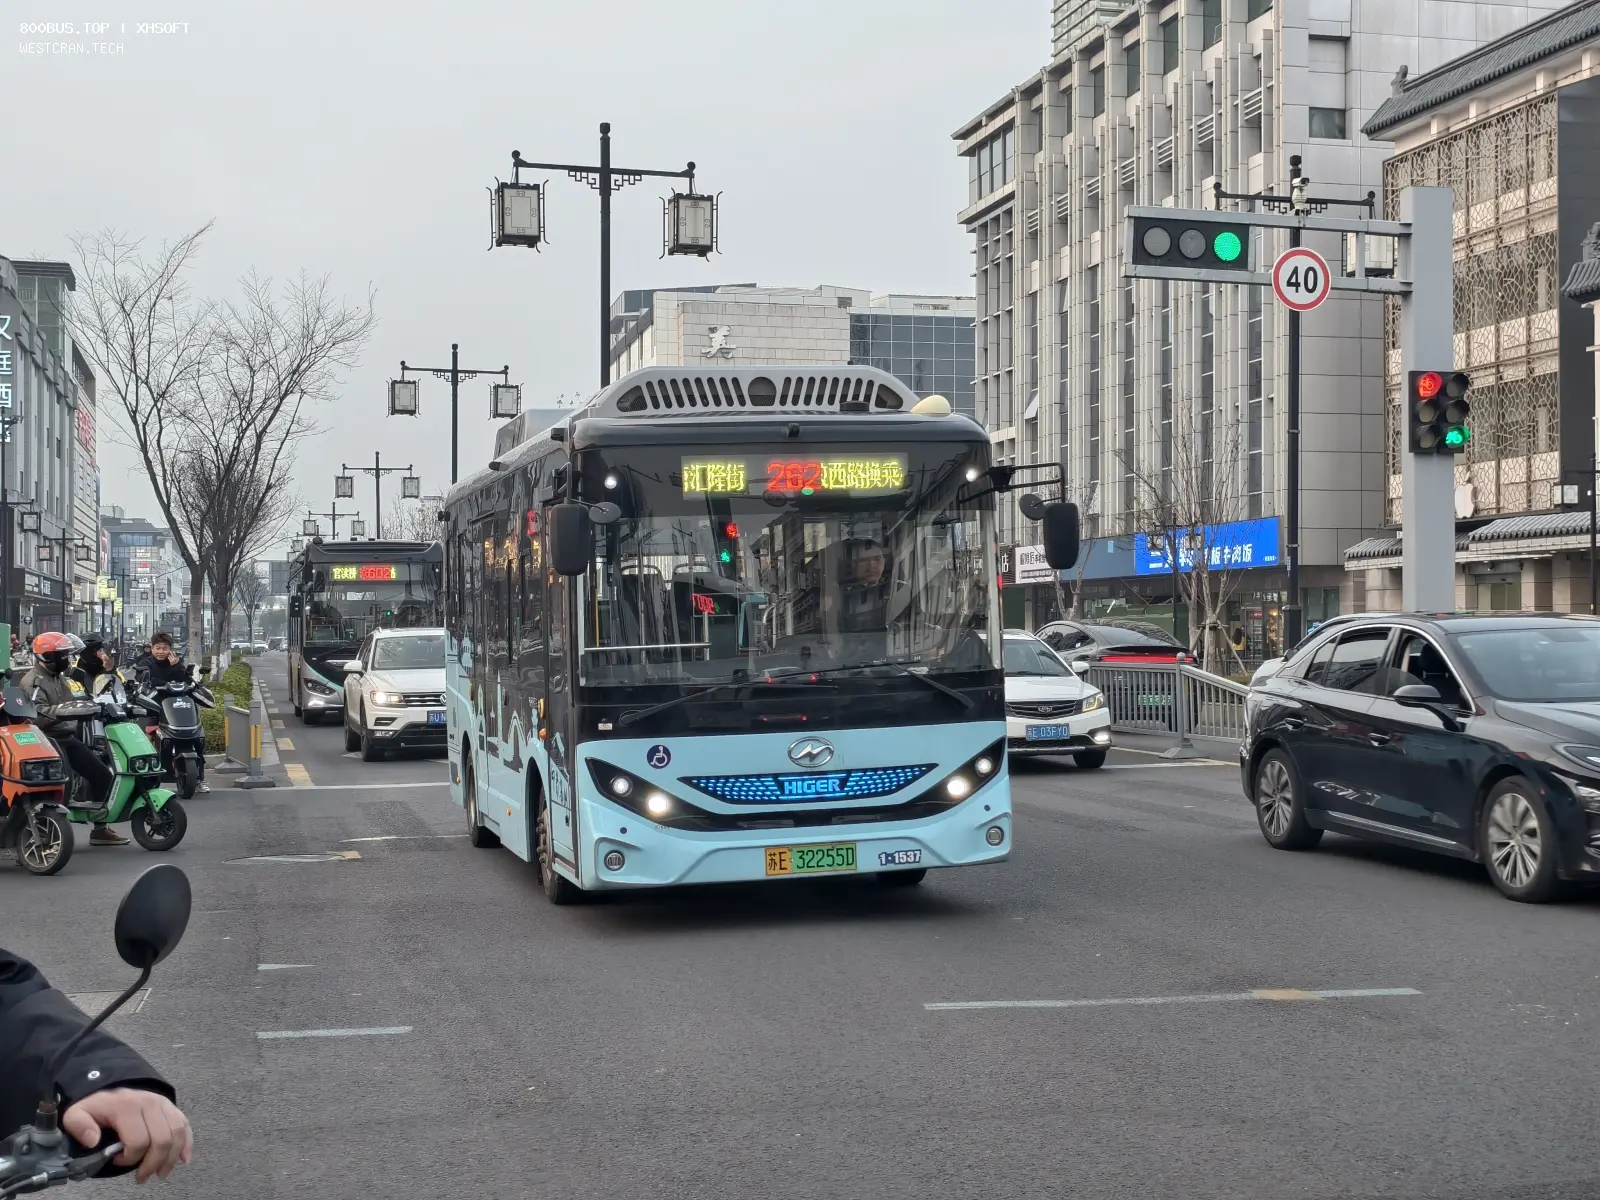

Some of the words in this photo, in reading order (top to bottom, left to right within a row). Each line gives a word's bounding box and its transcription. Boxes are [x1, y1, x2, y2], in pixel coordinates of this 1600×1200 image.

[1286, 265, 1318, 294] 40
[767, 463, 822, 491] 262
[820, 461, 902, 489] 西路换乘
[783, 779, 840, 795] HIGER
[768, 851, 788, 871] 苏E
[796, 847, 855, 869] 32255D
